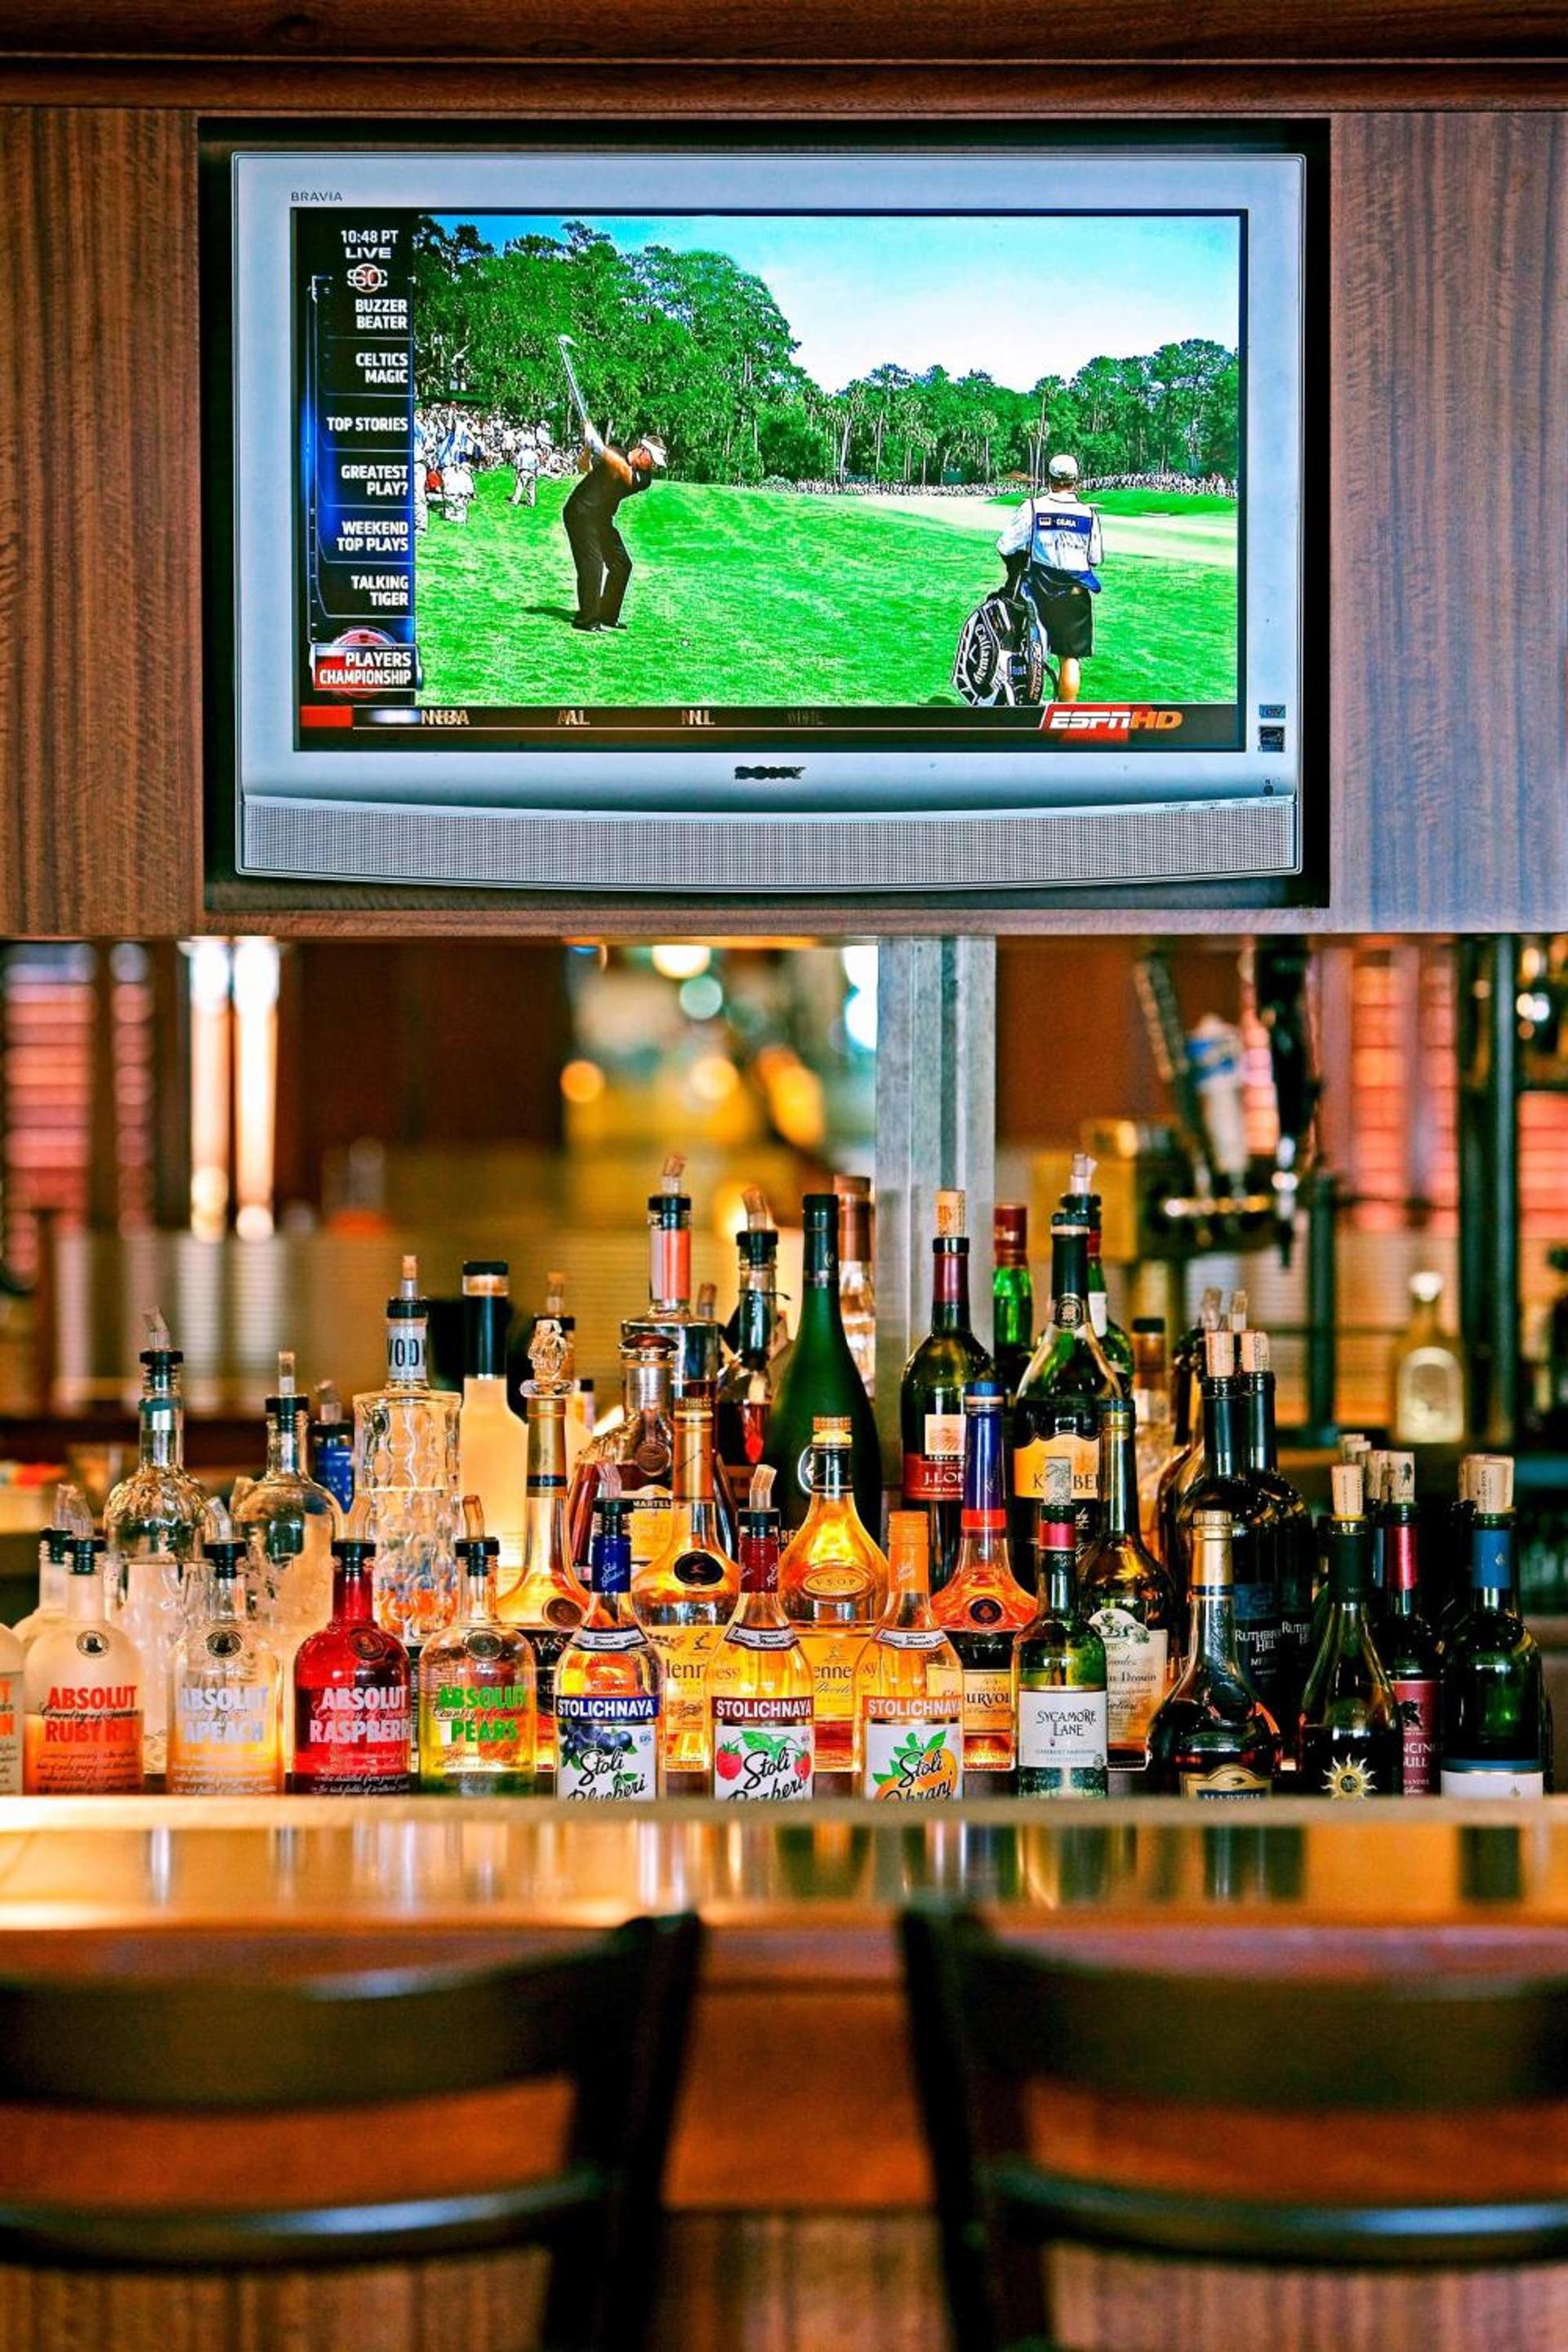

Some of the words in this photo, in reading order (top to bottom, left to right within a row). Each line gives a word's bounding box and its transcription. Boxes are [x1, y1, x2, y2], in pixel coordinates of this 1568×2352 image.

[291, 192, 343, 202] BRAVIA
[341, 230, 378, 243] 10:48
[381, 230, 399, 243] PT
[345, 247, 392, 259] LIVE
[355, 299, 408, 313] BUZZER
[356, 315, 408, 330] BEATER
[355, 353, 408, 367] CELTICS
[364, 370, 408, 383] MAGIC
[327, 417, 353, 431] TOP
[354, 417, 408, 432] STORIES
[341, 465, 408, 479] GREATEST
[367, 482, 408, 497] PLAY?
[341, 521, 408, 535] WEEKEND
[336, 537, 364, 551] TOP
[366, 537, 408, 552] PLAYS
[351, 575, 408, 590] TALKING
[370, 591, 408, 607] TIGER
[345, 652, 412, 667] PLAYERS
[319, 670, 412, 685] CHAMPIONSHIP
[48, 1686, 137, 1710] ABSOLUT
[181, 1686, 268, 1710] ABSOLUT
[322, 1686, 408, 1710] ABSOLUT
[438, 1686, 527, 1709] ABSOLUT
[965, 1693, 1010, 1708] URVOI
[558, 1699, 654, 1717] STOLICHNAYA
[715, 1699, 812, 1718] STOLICHNAYA
[1036, 1708, 1098, 1725] SYCAMORE
[46, 1719, 101, 1743] RUBY
[450, 1718, 519, 1743] PEARS
[1053, 1721, 1086, 1736] LANE
[579, 1747, 626, 1787] Stoli
[742, 1746, 791, 1790] Stoli
[898, 1749, 943, 1788] Stoli
[1403, 1757, 1429, 1768] ULL
